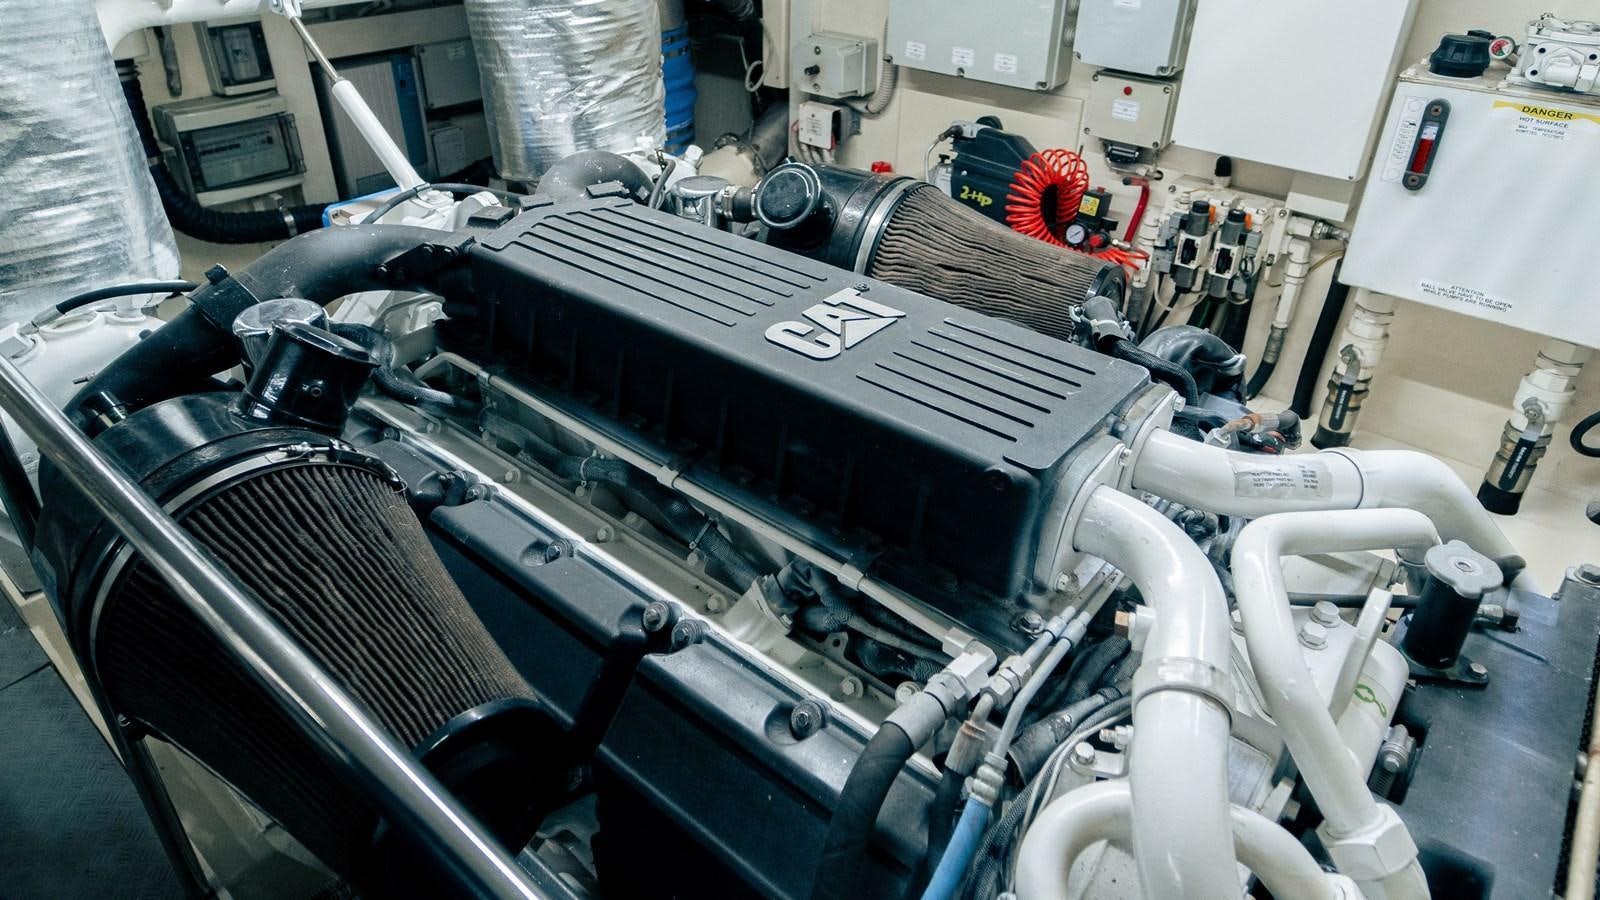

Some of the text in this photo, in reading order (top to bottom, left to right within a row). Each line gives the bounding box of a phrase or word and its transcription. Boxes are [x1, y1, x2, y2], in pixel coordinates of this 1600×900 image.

[1522, 106, 1573, 120] DANGER
[1535, 119, 1569, 129] SURFACE
[1421, 282, 1436, 290] BALL
[1438, 287, 1456, 295] VALVE
[1458, 291, 1473, 299] HAVE
[1494, 300, 1513, 309] OPEN
[1423, 288, 1441, 296] WHILE
[1479, 302, 1507, 312] RUNNING
[1450, 286, 1485, 297] ATTENTION
[765, 287, 906, 360] CAT
